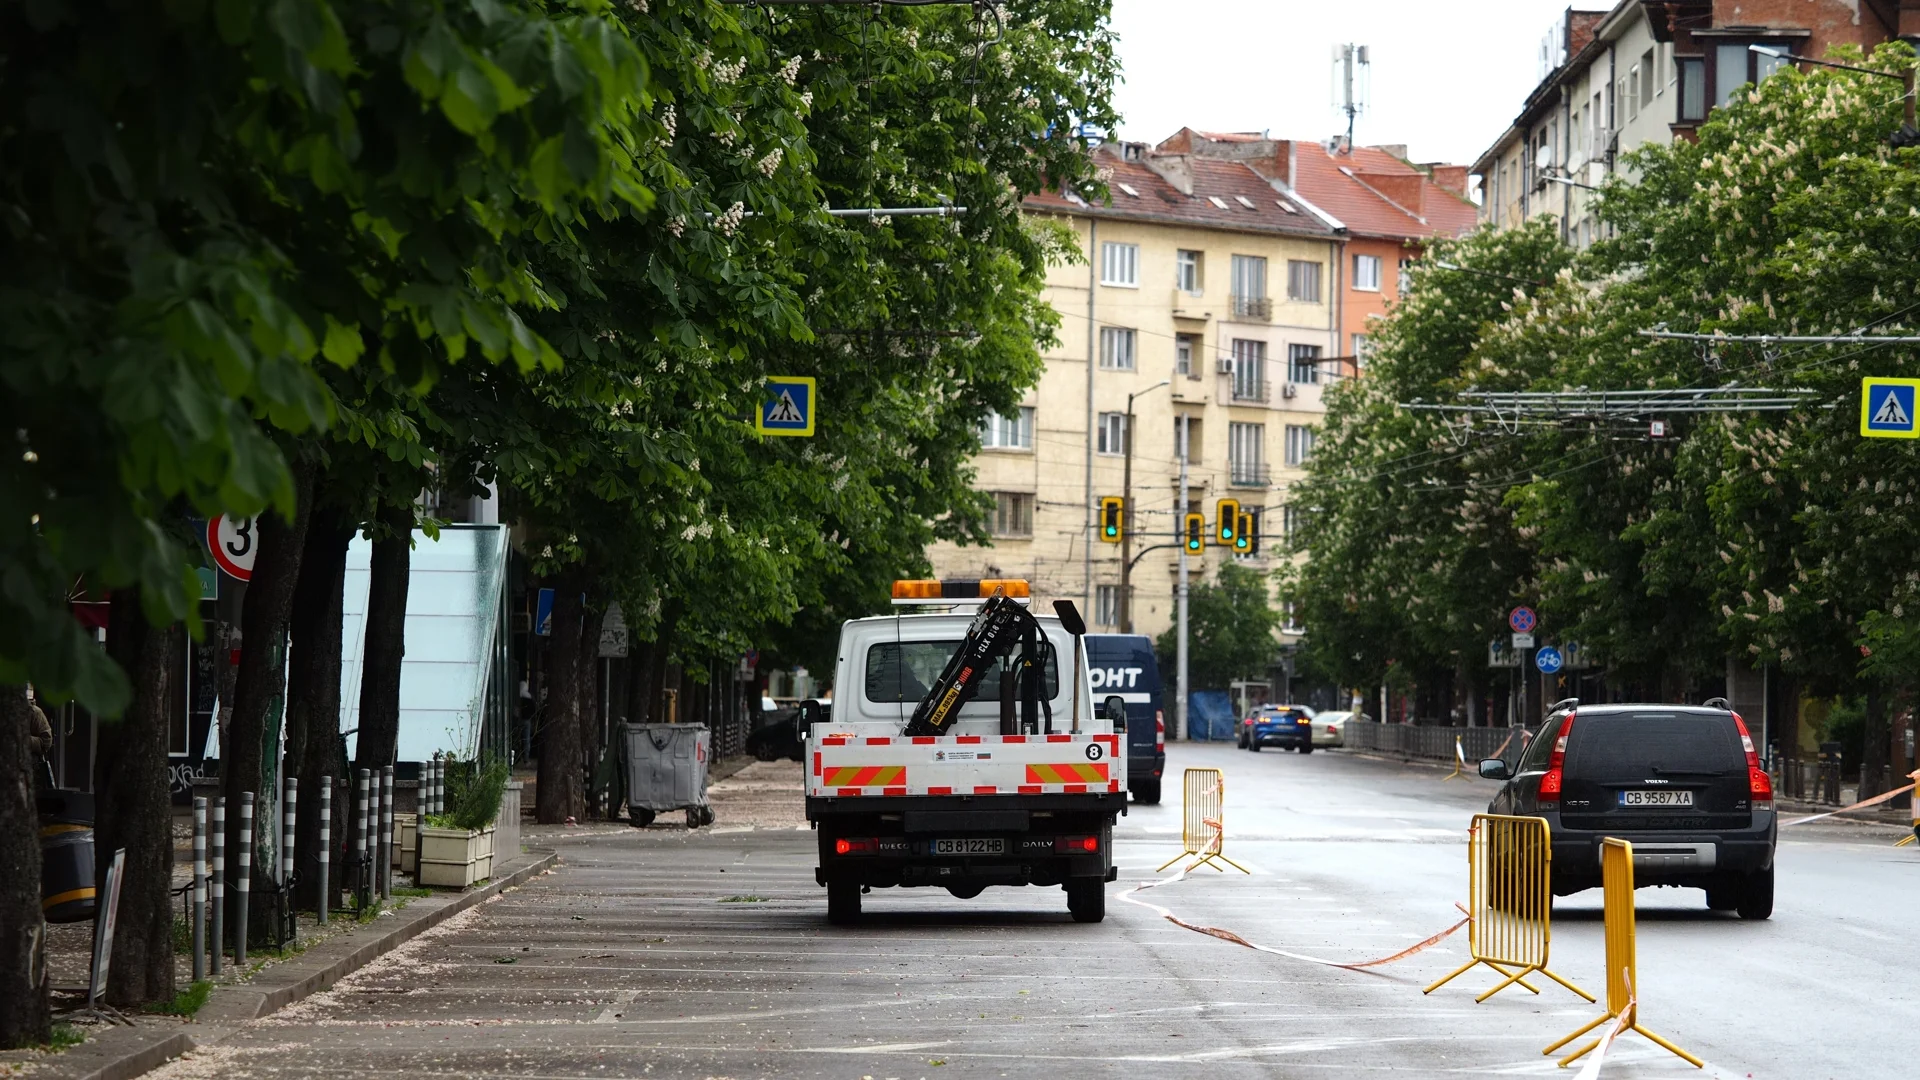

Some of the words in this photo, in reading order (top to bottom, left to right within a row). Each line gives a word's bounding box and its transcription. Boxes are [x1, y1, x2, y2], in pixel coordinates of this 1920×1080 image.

[227, 515, 251, 556] 3
[958, 666, 973, 684] HIAB
[1089, 746, 1099, 758] 8
[1626, 792, 1642, 804] CB
[1644, 792, 1673, 804] 9587
[1675, 792, 1690, 804] XA
[937, 840, 954, 853] CB
[955, 840, 985, 852] 8122
[986, 839, 1003, 852] HB
